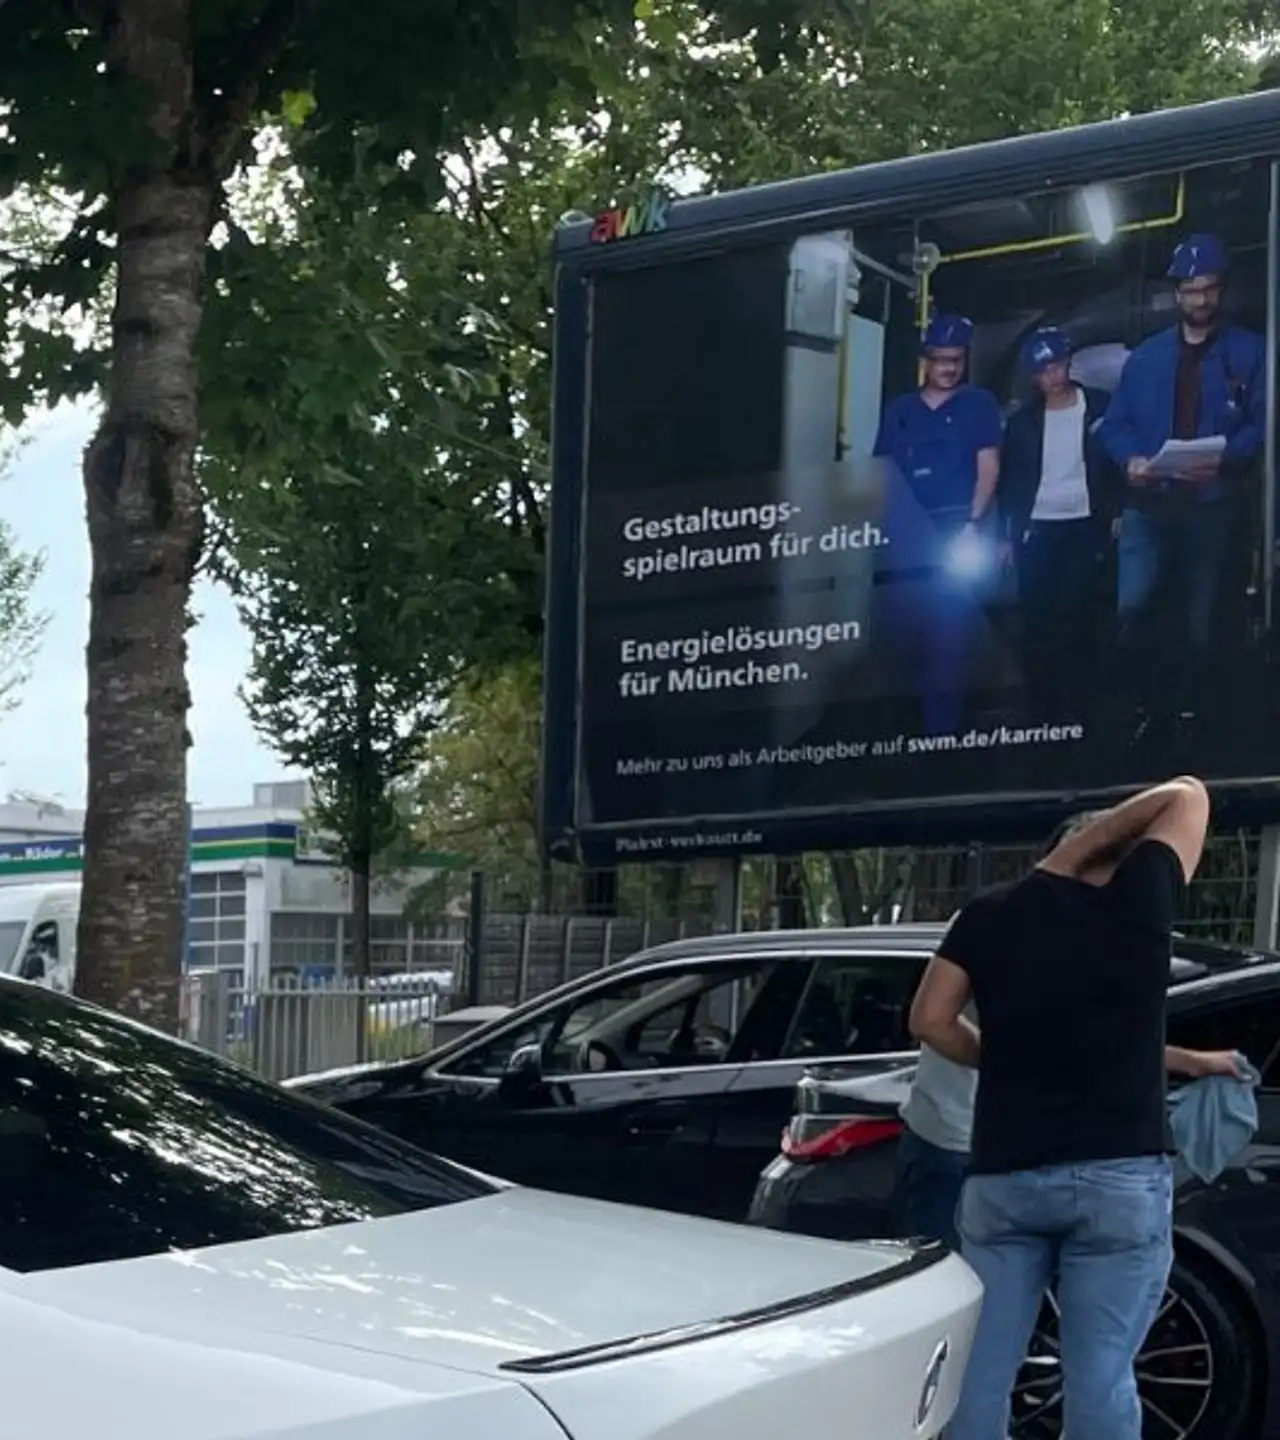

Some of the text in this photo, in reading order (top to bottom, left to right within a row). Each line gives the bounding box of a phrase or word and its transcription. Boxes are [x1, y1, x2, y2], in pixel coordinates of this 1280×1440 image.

[623, 501, 801, 541] Gestaltungs-
[622, 521, 890, 580] spielraum für dich.
[620, 620, 860, 663] Energielösungen
[619, 660, 809, 697] für München.
[616, 722, 1084, 775] Mehr zu uns als Arbeitgeber auf swm.de/karriere
